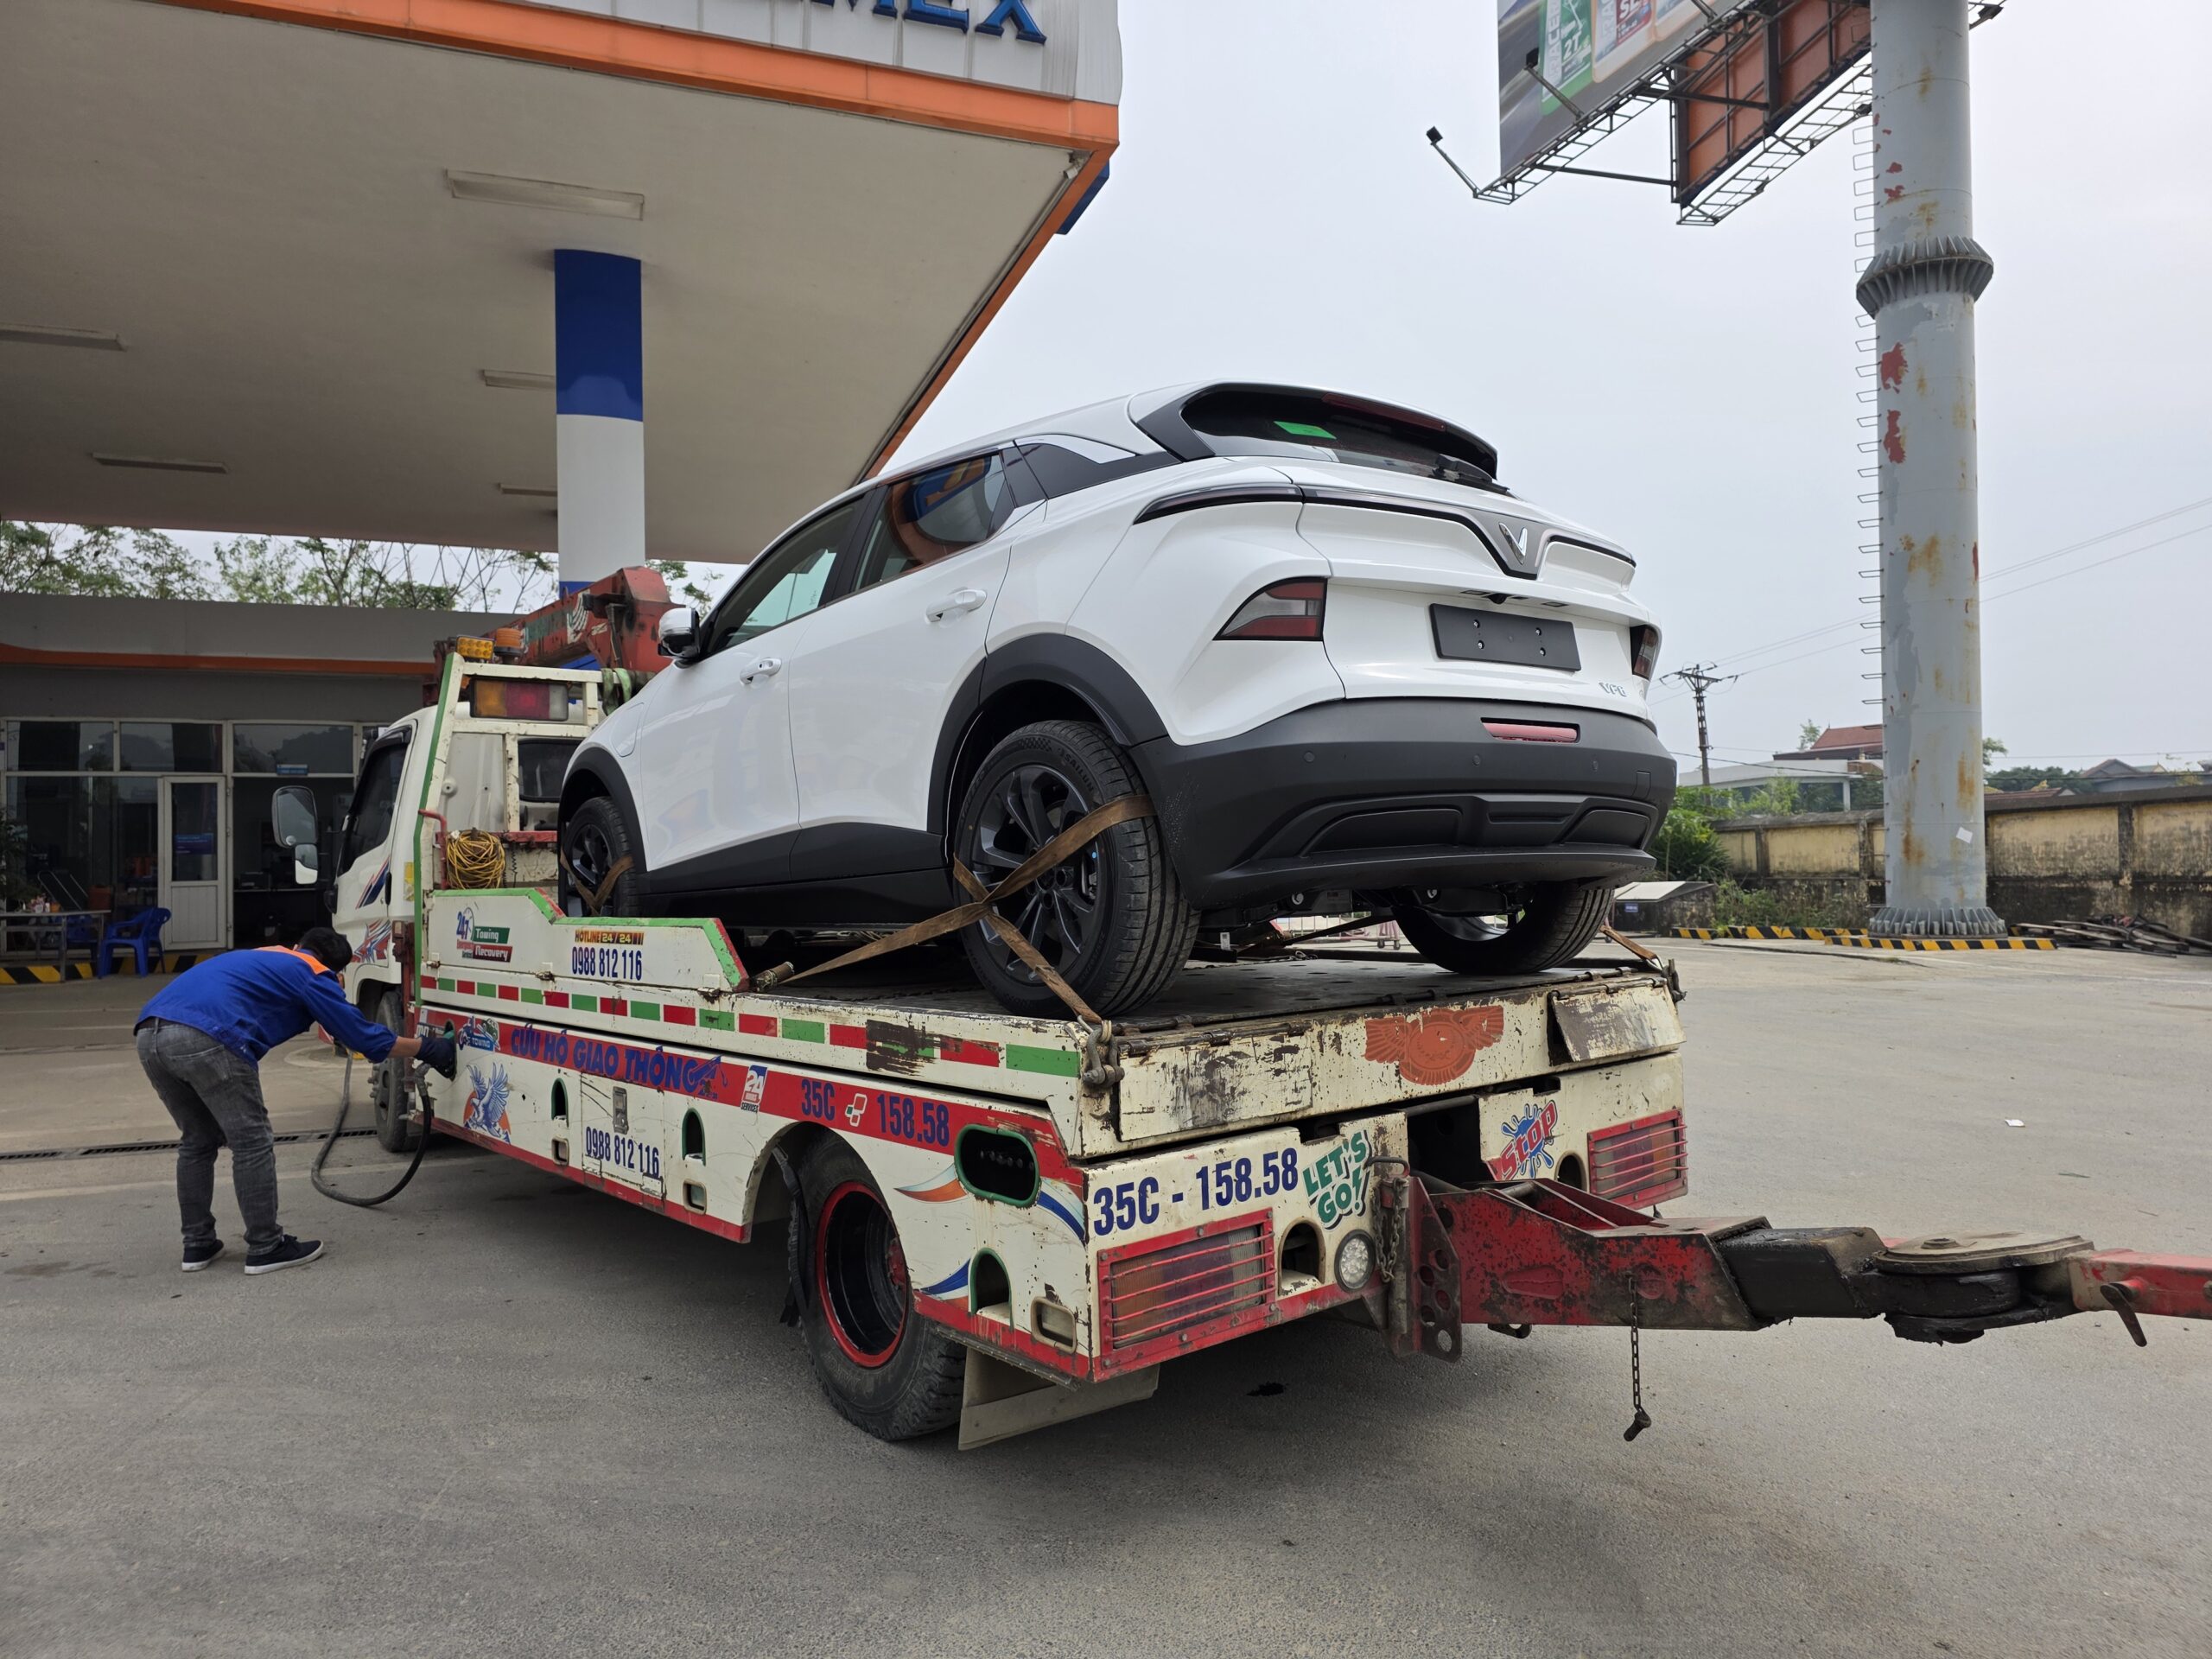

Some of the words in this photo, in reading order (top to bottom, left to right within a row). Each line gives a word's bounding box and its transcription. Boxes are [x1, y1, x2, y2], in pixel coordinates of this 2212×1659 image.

[1563, 30, 1582, 60] 2T
[474, 945, 509, 962] Recovery
[475, 928, 499, 943] Towing
[575, 930, 601, 944] HOTLINE
[572, 946, 595, 976] 0988
[599, 947, 618, 978] 812
[622, 950, 642, 981] 116
[573, 1039, 620, 1077] GIAO
[746, 1070, 765, 1092] 24
[801, 1078, 836, 1121] 35C
[877, 1094, 950, 1147] 158.58
[586, 1126, 611, 1162] 0988
[613, 1134, 635, 1170] 812
[639, 1141, 660, 1178] 116
[1500, 1100, 1558, 1181] Stop
[1302, 1131, 1368, 1198] LET'S
[1093, 1177, 1160, 1236] 35C
[1196, 1147, 1299, 1210] 158.58
[1317, 1166, 1364, 1224] GO!
